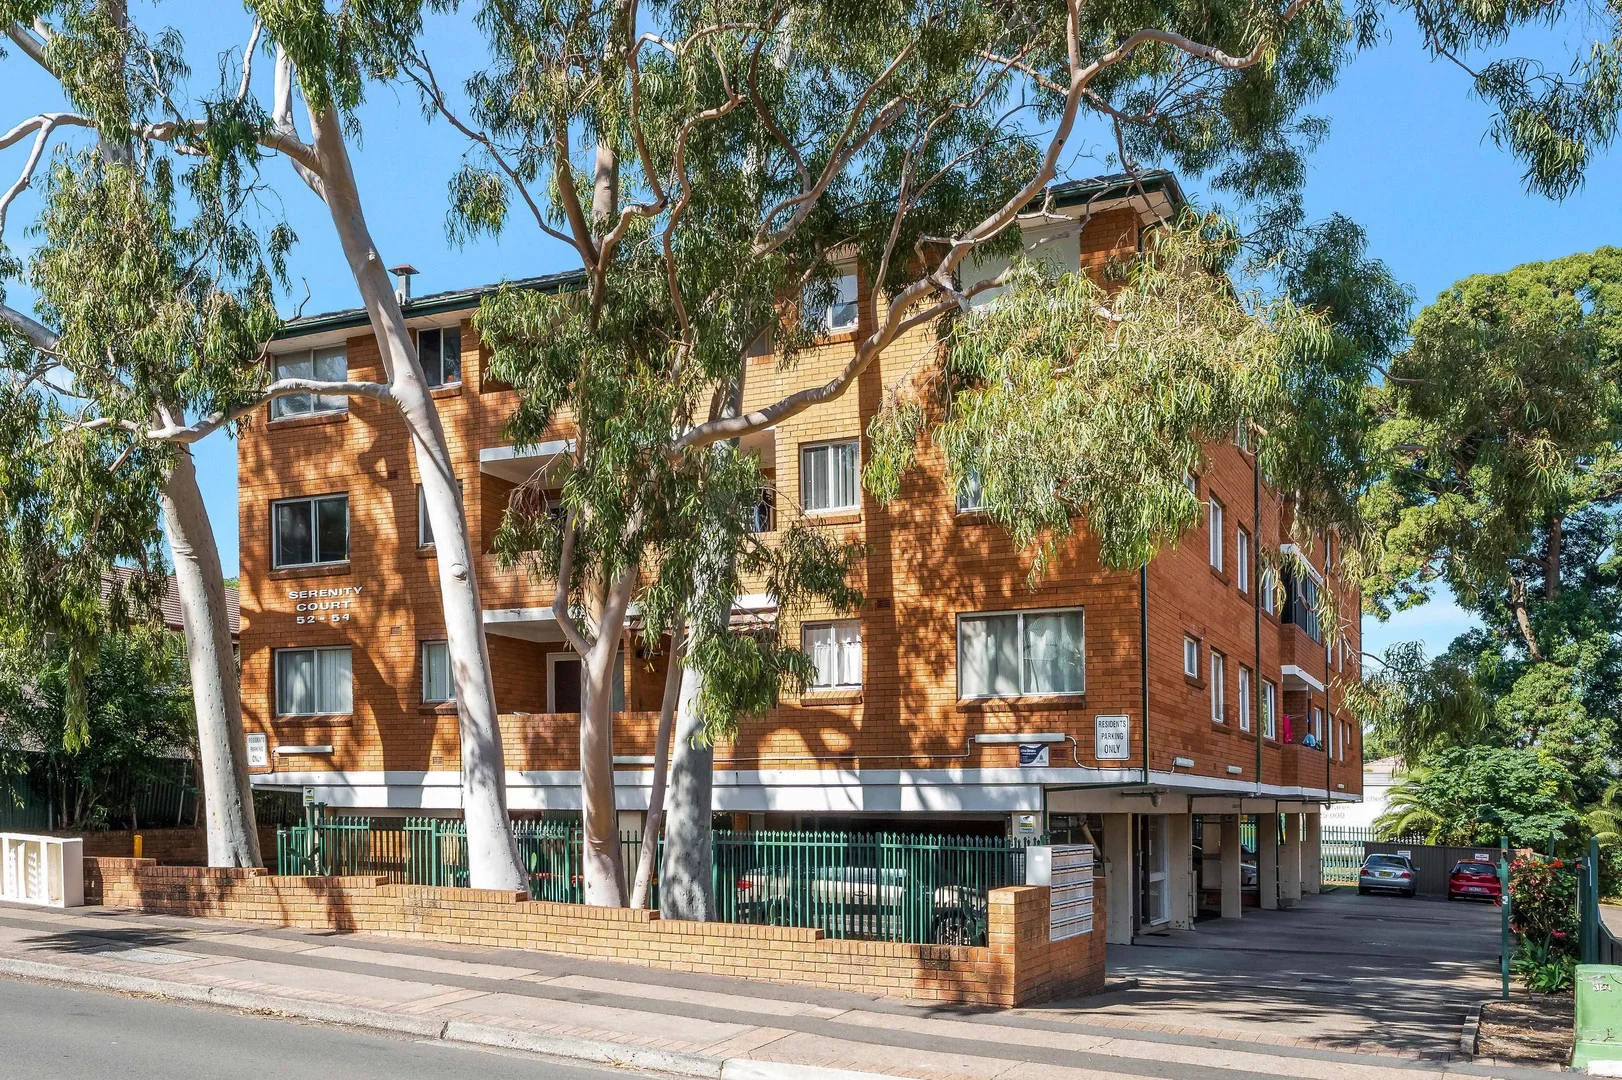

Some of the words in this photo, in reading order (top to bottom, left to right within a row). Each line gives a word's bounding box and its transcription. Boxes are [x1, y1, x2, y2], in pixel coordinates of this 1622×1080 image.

[288, 586, 363, 599] SERENITY
[296, 600, 352, 612] COURT
[296, 615, 316, 624] 52
[331, 613, 350, 622] 54
[1098, 720, 1127, 728] RESIDENTS
[1104, 744, 1121, 754] ONLY
